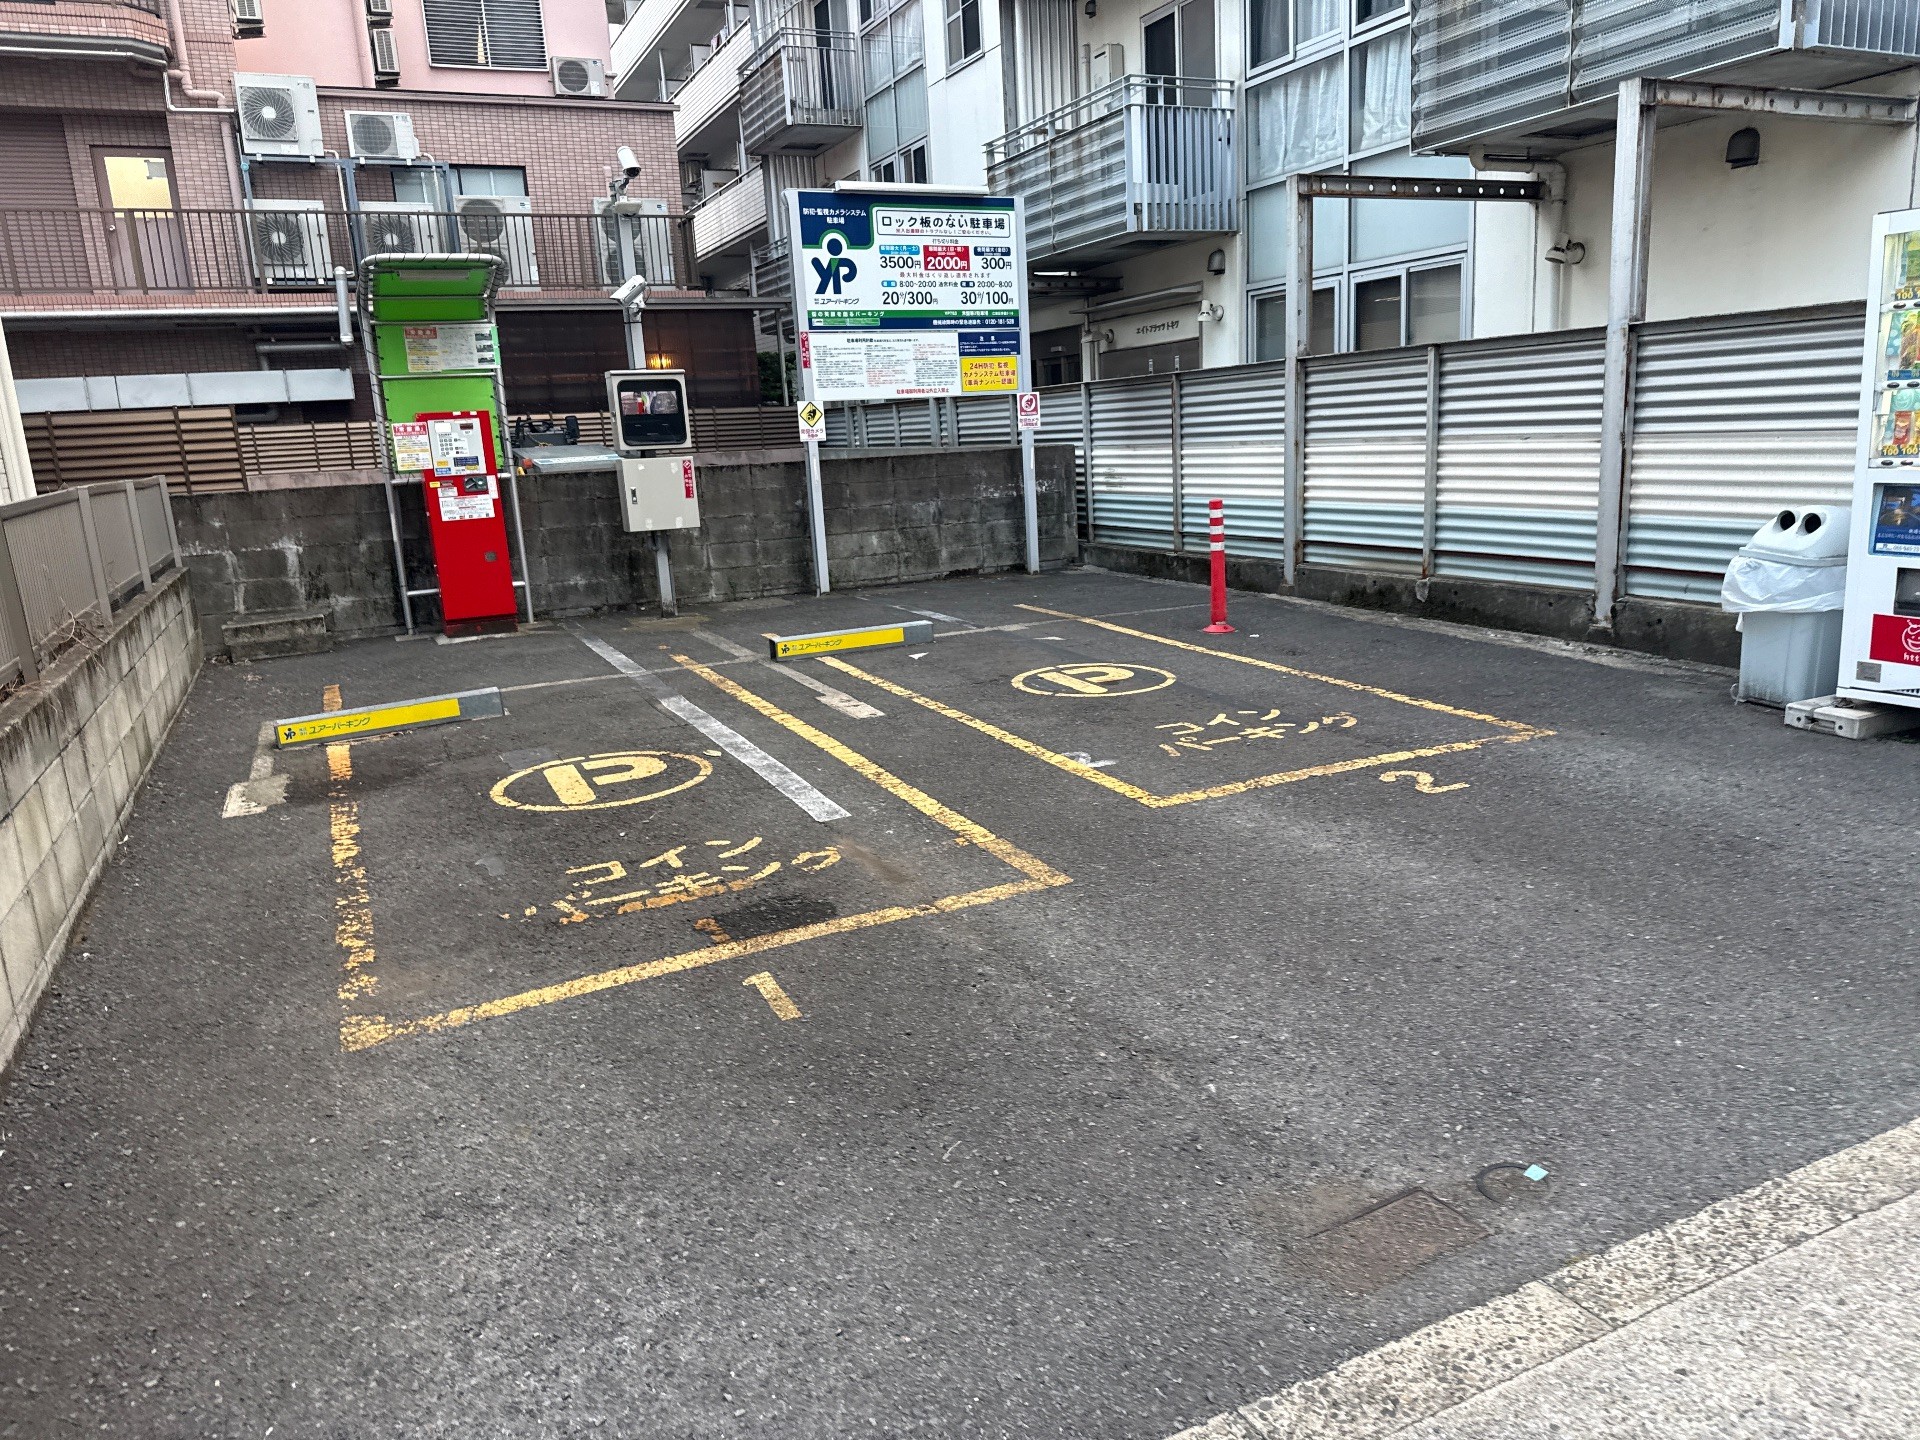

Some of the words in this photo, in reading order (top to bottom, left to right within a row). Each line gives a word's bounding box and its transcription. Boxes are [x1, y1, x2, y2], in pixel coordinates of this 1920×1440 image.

[826, 216, 845, 225] 駐車場
[882, 214, 1005, 230] ロック板のない駐車場
[880, 256, 921, 269] 3500円
[927, 256, 968, 270] 2000円
[981, 257, 1012, 270] 300円
[1155, 708, 1281, 735] コイン
[1159, 711, 1357, 757] パーキング
[1378, 769, 1470, 796] 2
[565, 836, 763, 887] コイン
[742, 970, 803, 1021] 1
